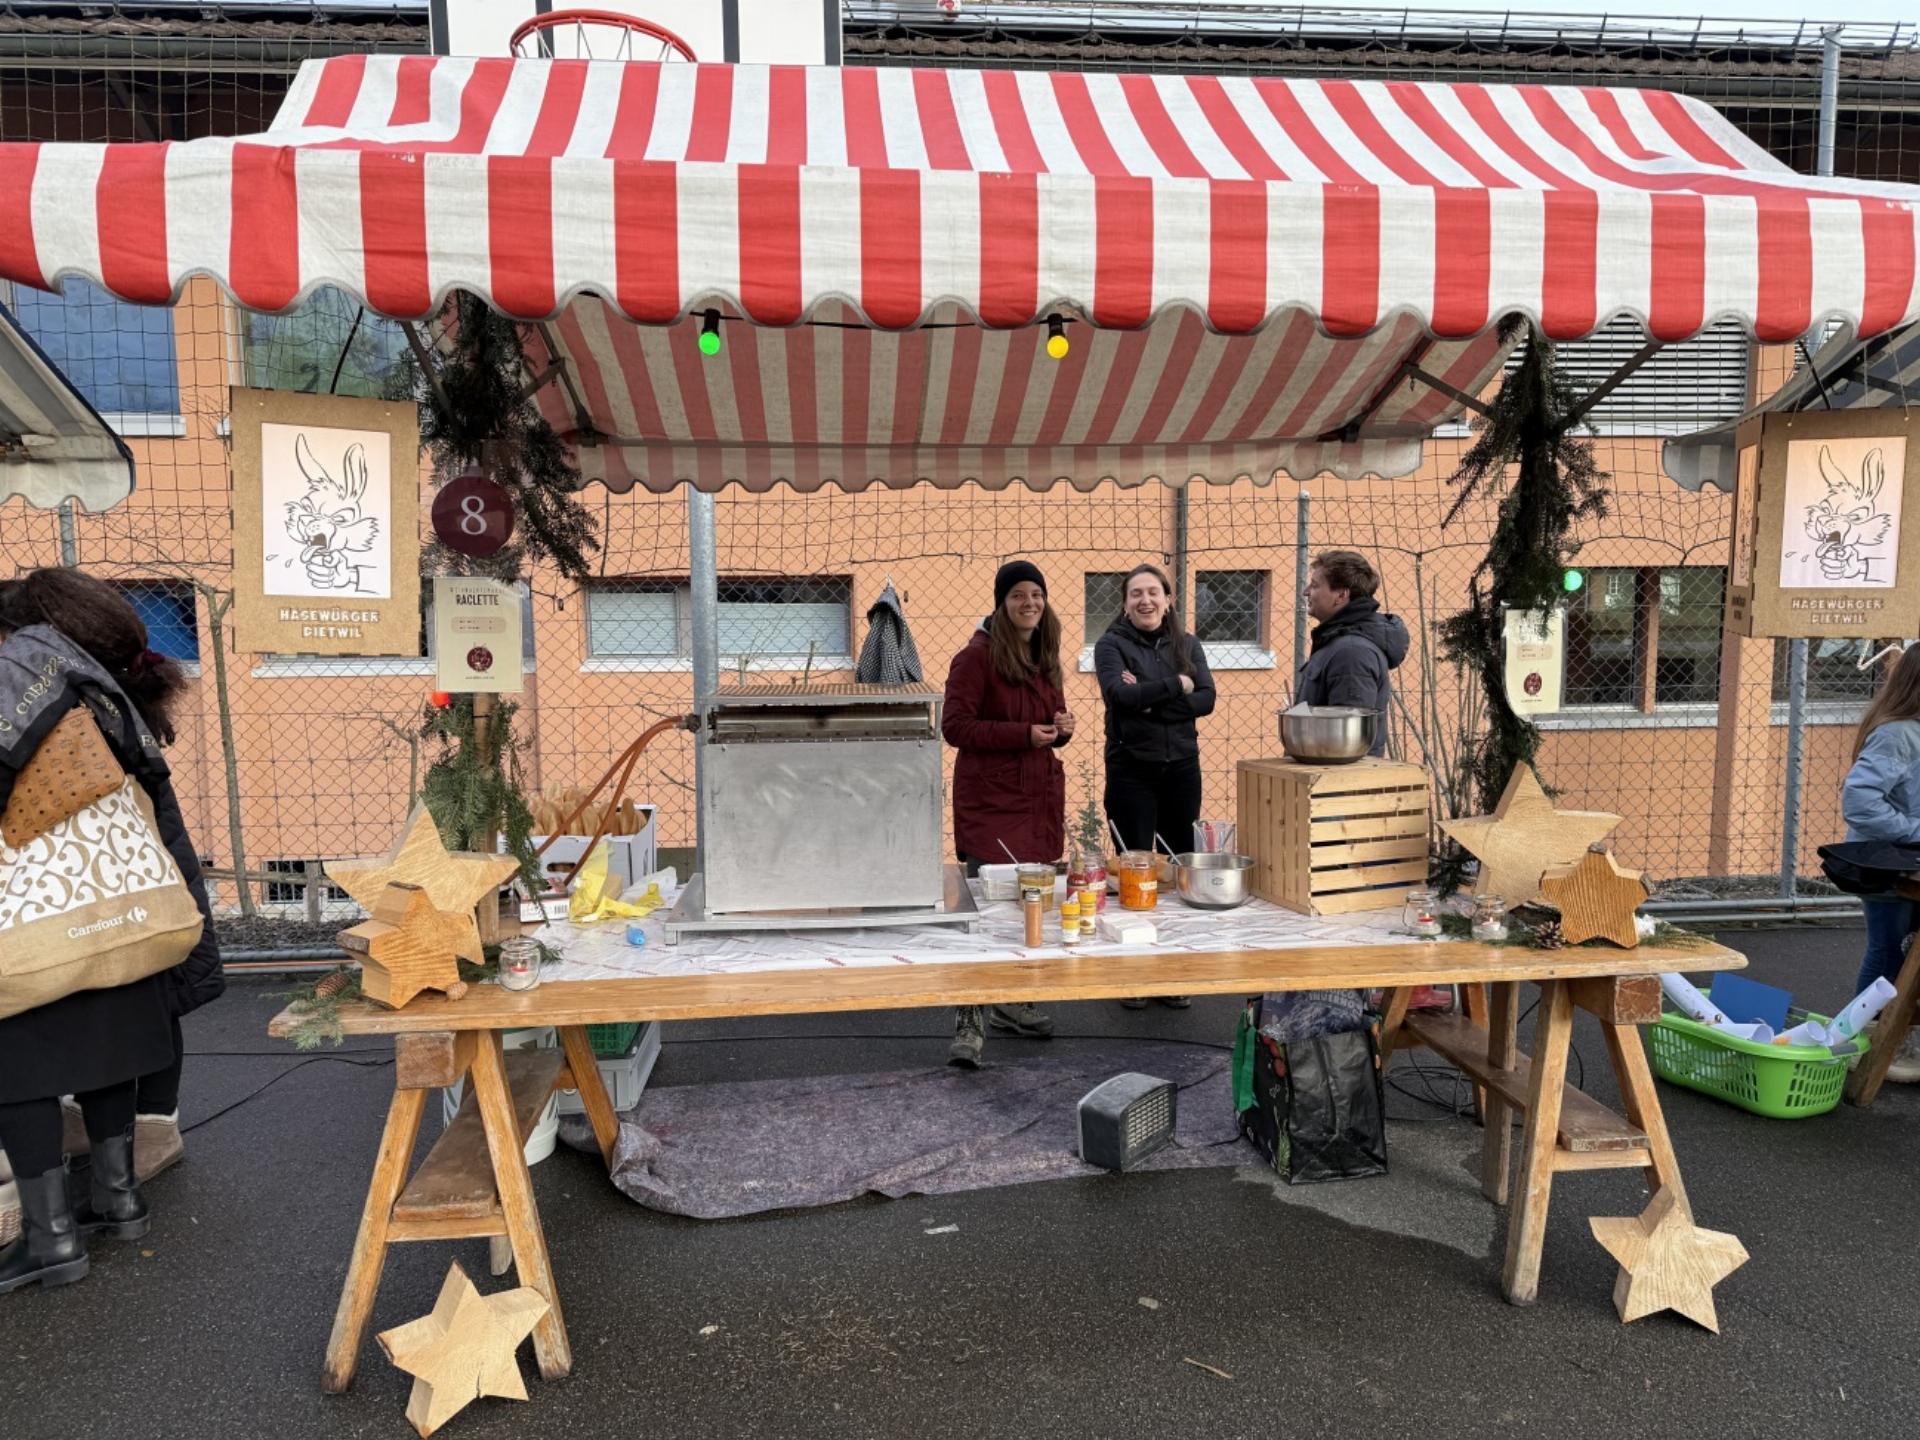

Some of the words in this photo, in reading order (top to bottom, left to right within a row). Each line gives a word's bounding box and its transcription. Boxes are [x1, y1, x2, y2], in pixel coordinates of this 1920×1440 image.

[461, 495, 487, 535] 8
[456, 594, 499, 606] RACLETTE
[1792, 597, 1882, 609] HASEWÜRGER
[279, 607, 379, 622] HASEWÜRGER
[1811, 613, 1866, 624] DIETWIL
[302, 626, 362, 638] DIETWIL
